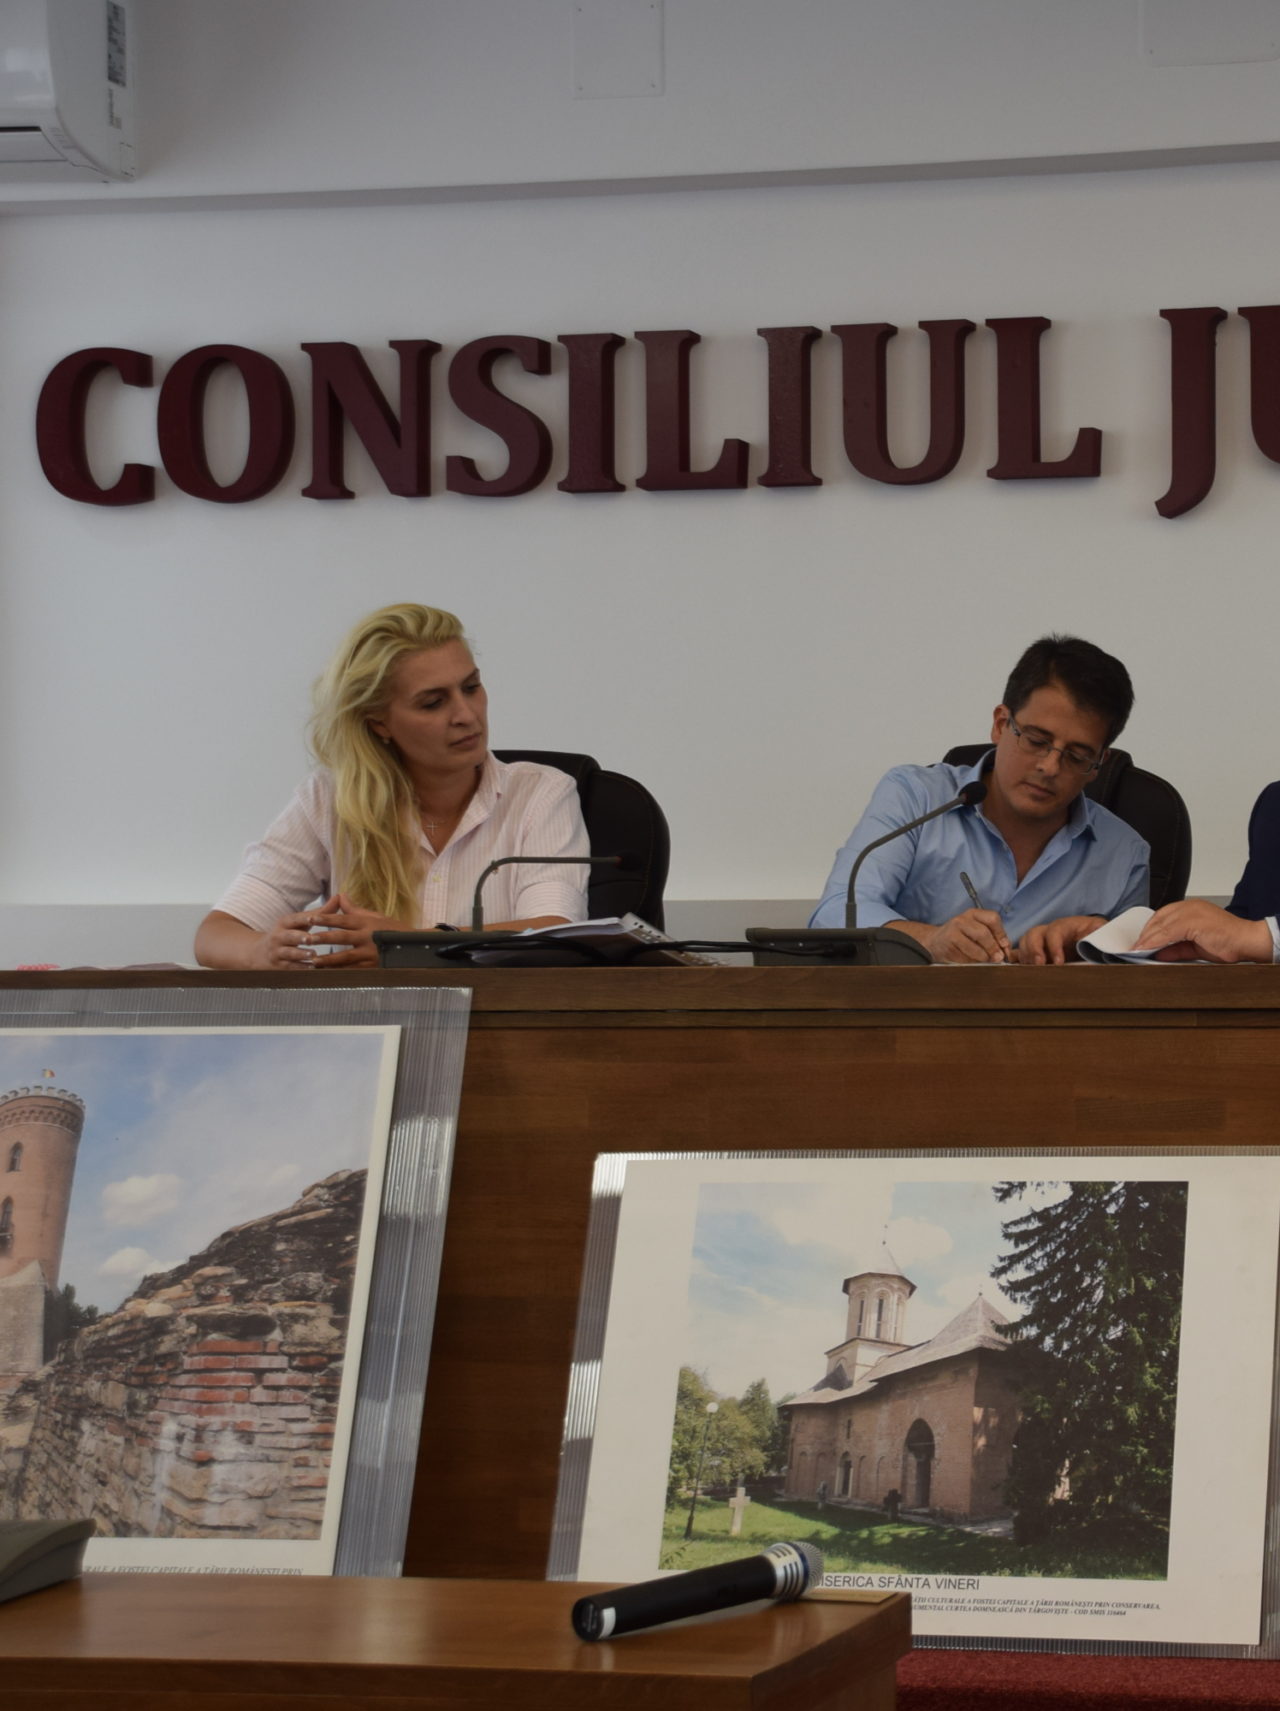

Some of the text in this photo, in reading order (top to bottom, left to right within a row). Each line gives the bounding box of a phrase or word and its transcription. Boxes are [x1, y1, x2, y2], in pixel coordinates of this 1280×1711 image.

[36, 315, 1102, 507] CONSILIUL
[815, 1574, 980, 1590] ISERICA SFÂNTA VINERI
